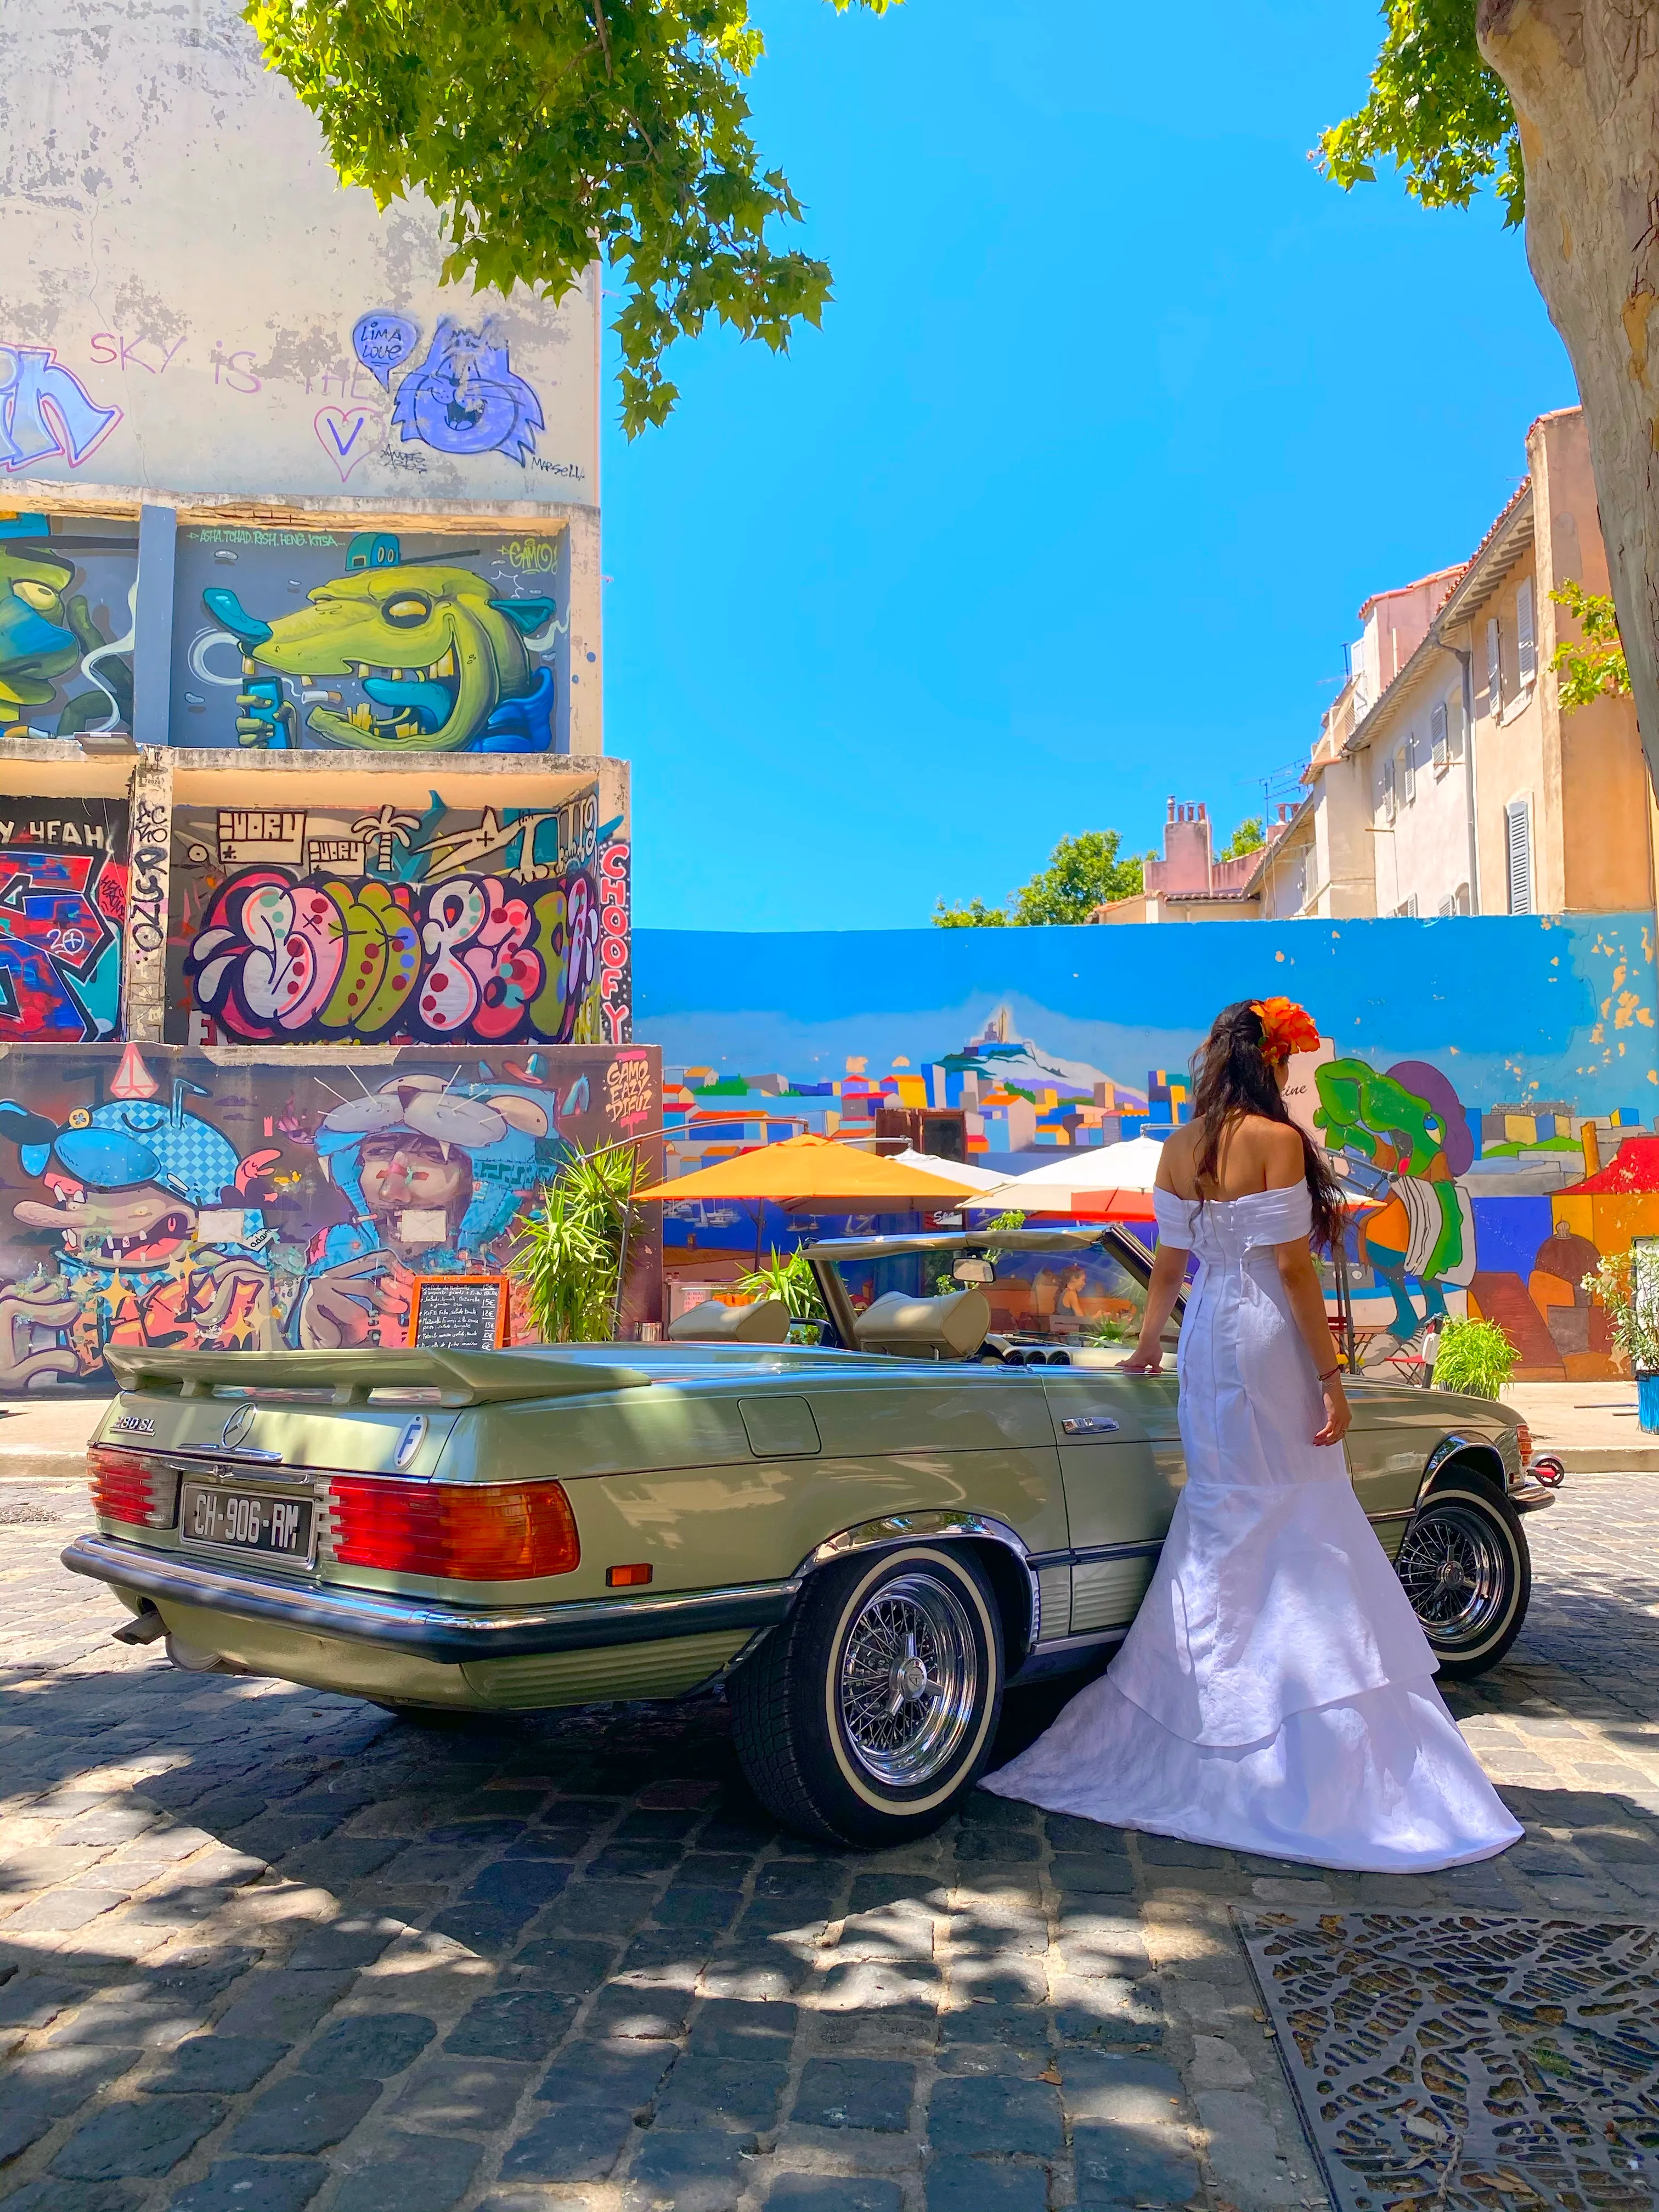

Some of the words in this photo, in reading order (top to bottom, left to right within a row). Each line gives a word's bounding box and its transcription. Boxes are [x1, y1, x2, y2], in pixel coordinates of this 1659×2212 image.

[600, 844, 630, 1045] CHOOFY
[607, 1060, 648, 1086] GAMO
[610, 1075, 651, 1104] EAZY
[1281, 1085, 1307, 1096] ine
[605, 1089, 652, 1122] DIFUZ
[139, 1418, 155, 1432] SL
[398, 1425, 422, 1458] F
